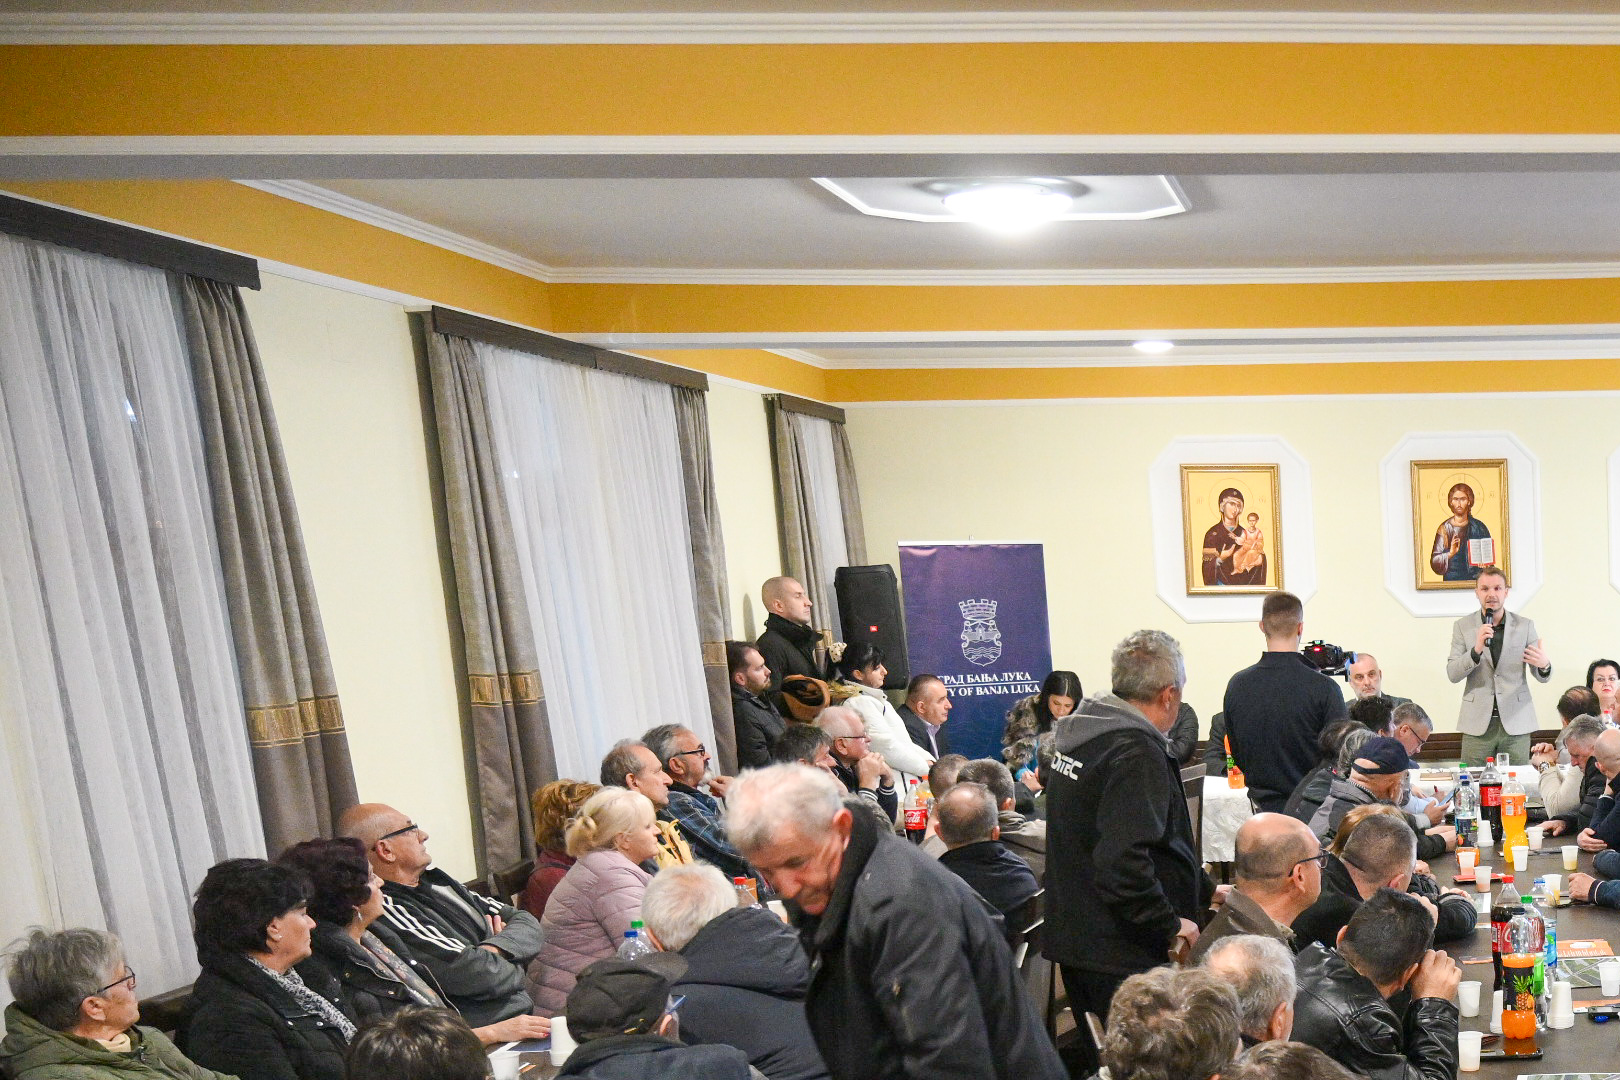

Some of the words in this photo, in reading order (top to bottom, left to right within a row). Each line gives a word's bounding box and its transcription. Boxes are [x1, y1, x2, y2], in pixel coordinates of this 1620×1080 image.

[967, 673, 999, 683] БАЊА
[1000, 671, 1031, 681] ЛУКА
[958, 687, 974, 696] OF
[976, 685, 1009, 696] BANJA
[1010, 684, 1041, 694] LUKA
